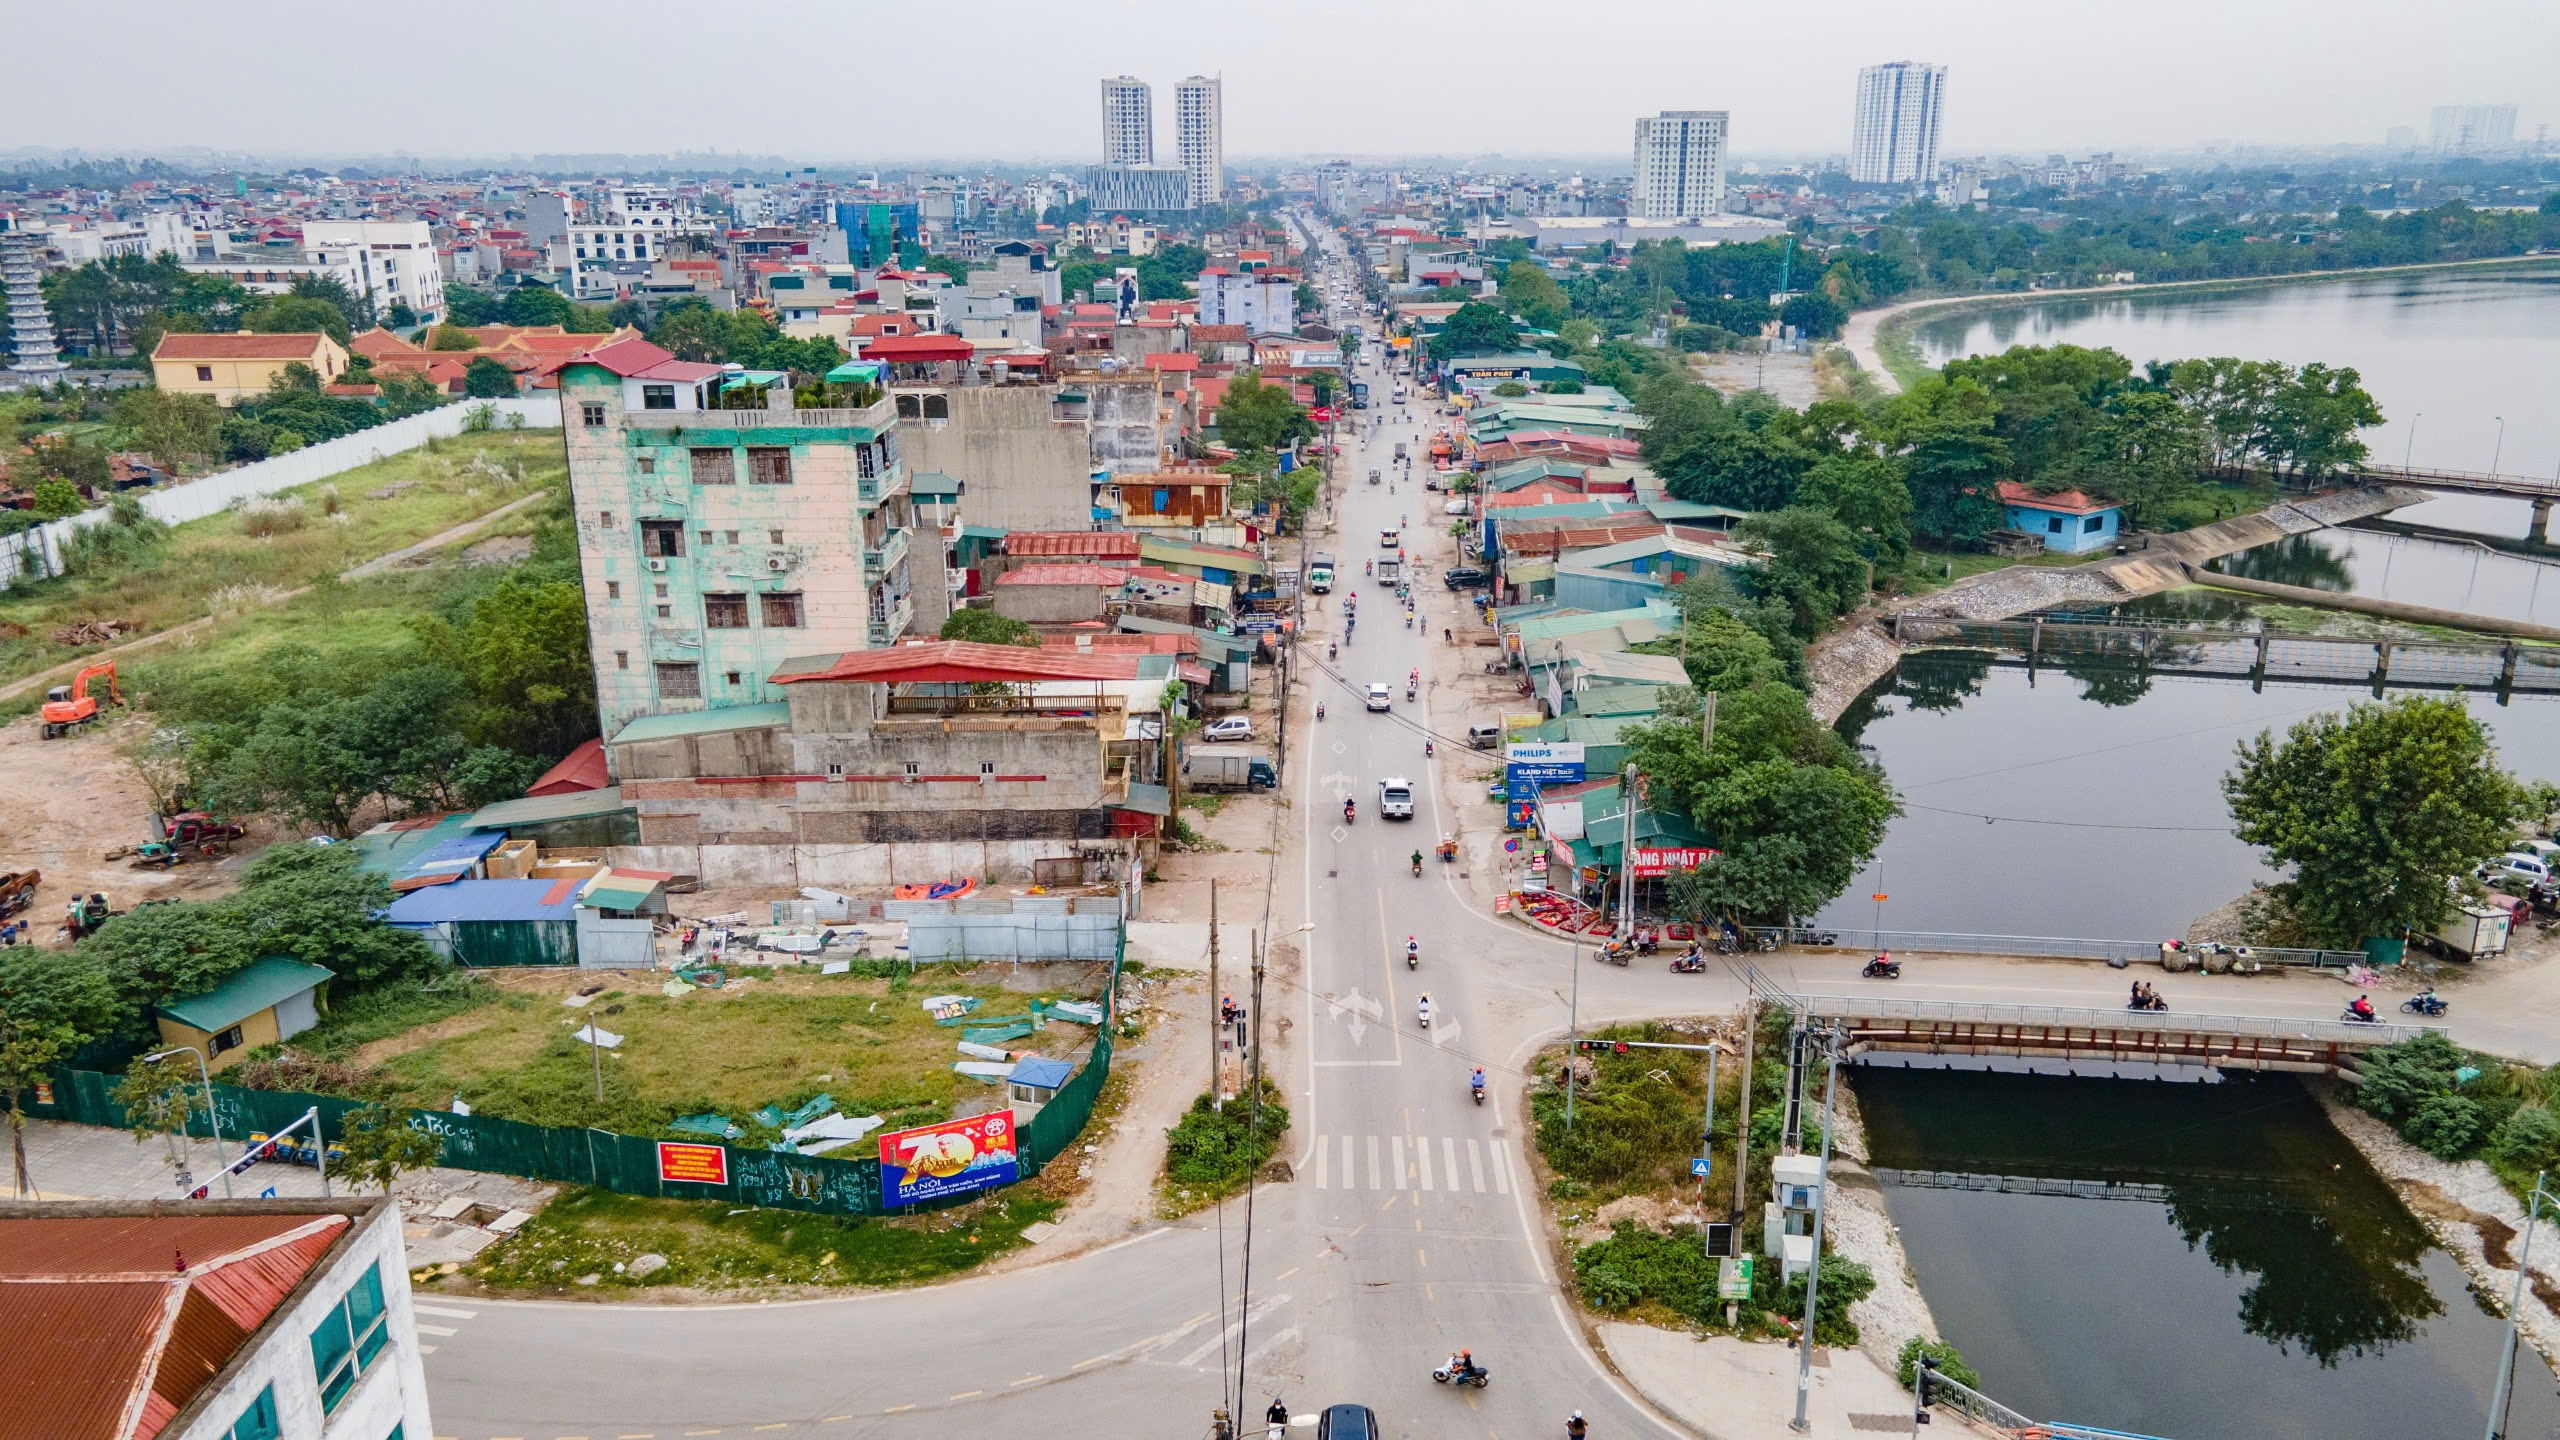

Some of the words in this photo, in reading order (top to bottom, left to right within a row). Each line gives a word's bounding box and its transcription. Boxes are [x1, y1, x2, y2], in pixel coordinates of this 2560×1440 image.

[1512, 749, 1552, 758] PHILIPS
[1662, 849, 1696, 868] NHẬT
[899, 1184, 917, 1195] HÀ
[919, 1179, 941, 1190] NỘI
